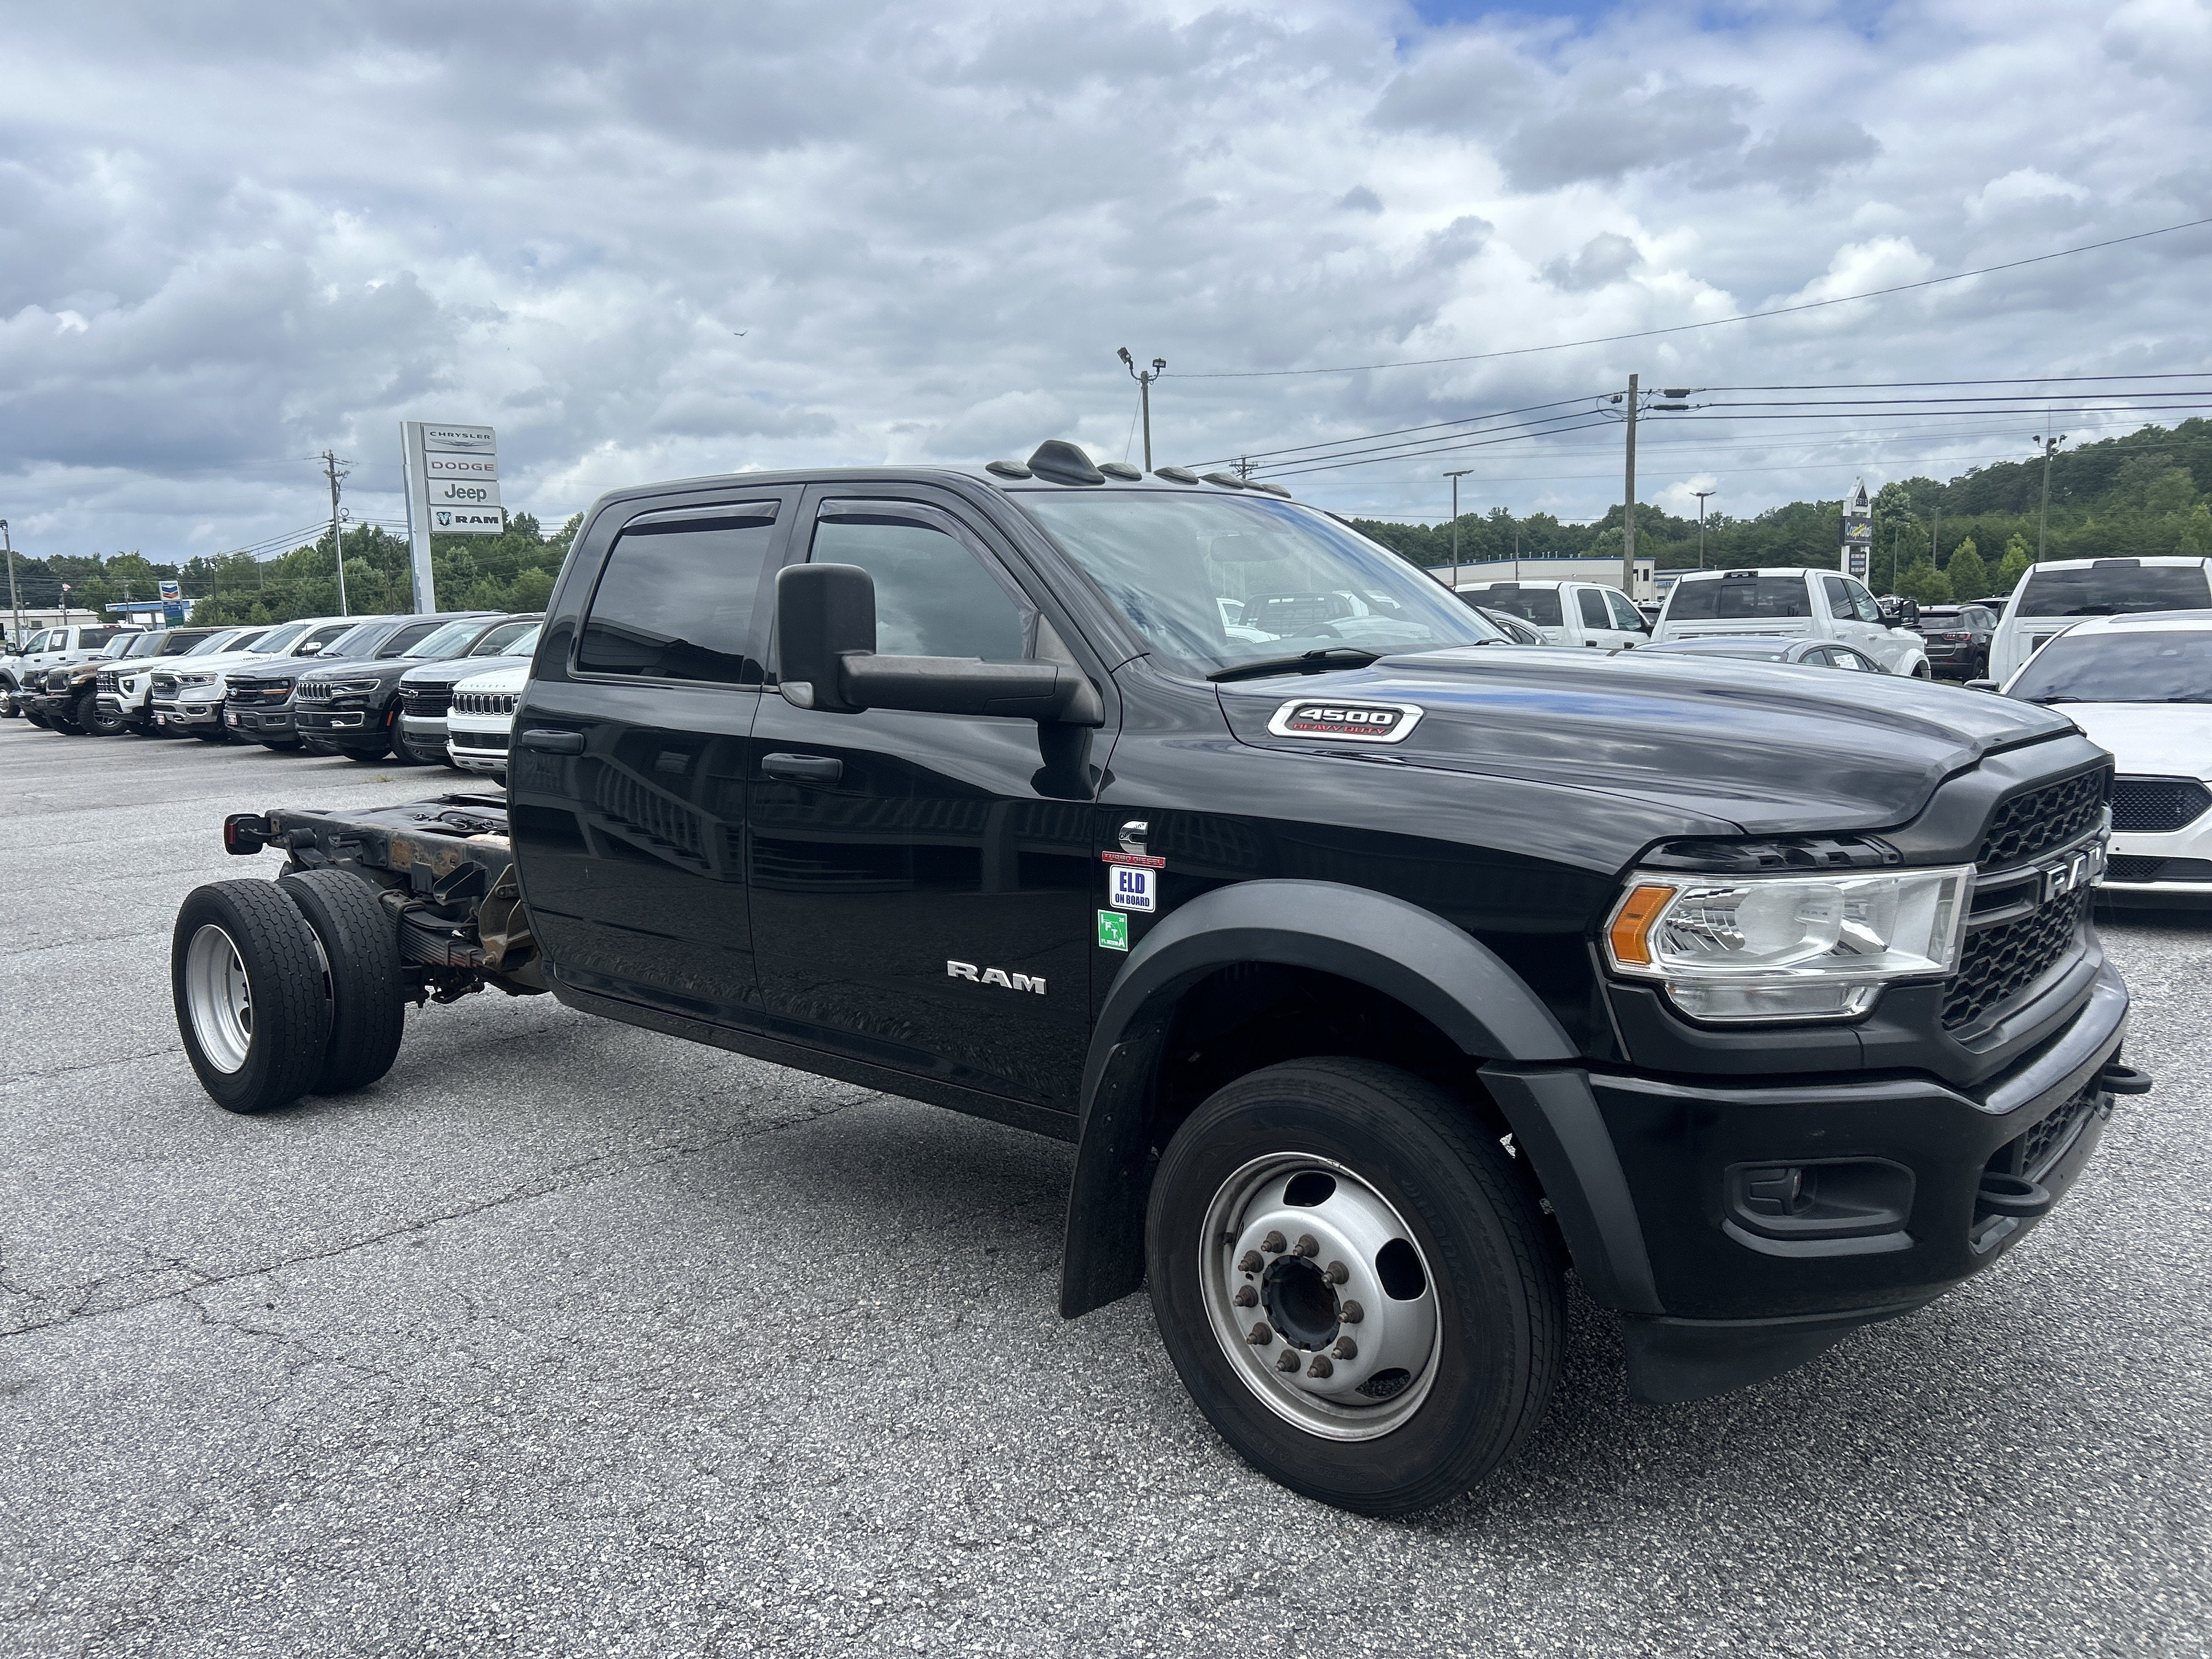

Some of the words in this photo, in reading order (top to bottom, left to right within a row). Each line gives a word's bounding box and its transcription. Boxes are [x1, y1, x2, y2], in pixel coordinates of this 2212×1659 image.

[430, 431, 490, 439] CHRYSLER
[431, 461, 494, 471] DODGE
[444, 483, 487, 502] Jeep
[455, 515, 499, 524] RAM
[1299, 709, 1393, 725] 4500
[1293, 723, 1343, 731] HEAVY
[1344, 726, 1387, 735] DUTY
[1119, 822, 1145, 839] Cummins
[1103, 853, 1131, 862] TURBO
[1132, 856, 1164, 866] DIESEL
[1120, 871, 1145, 894] ELD
[1115, 893, 1125, 904] ON
[1126, 894, 1150, 907] BOARD
[947, 960, 1047, 995] RAM
